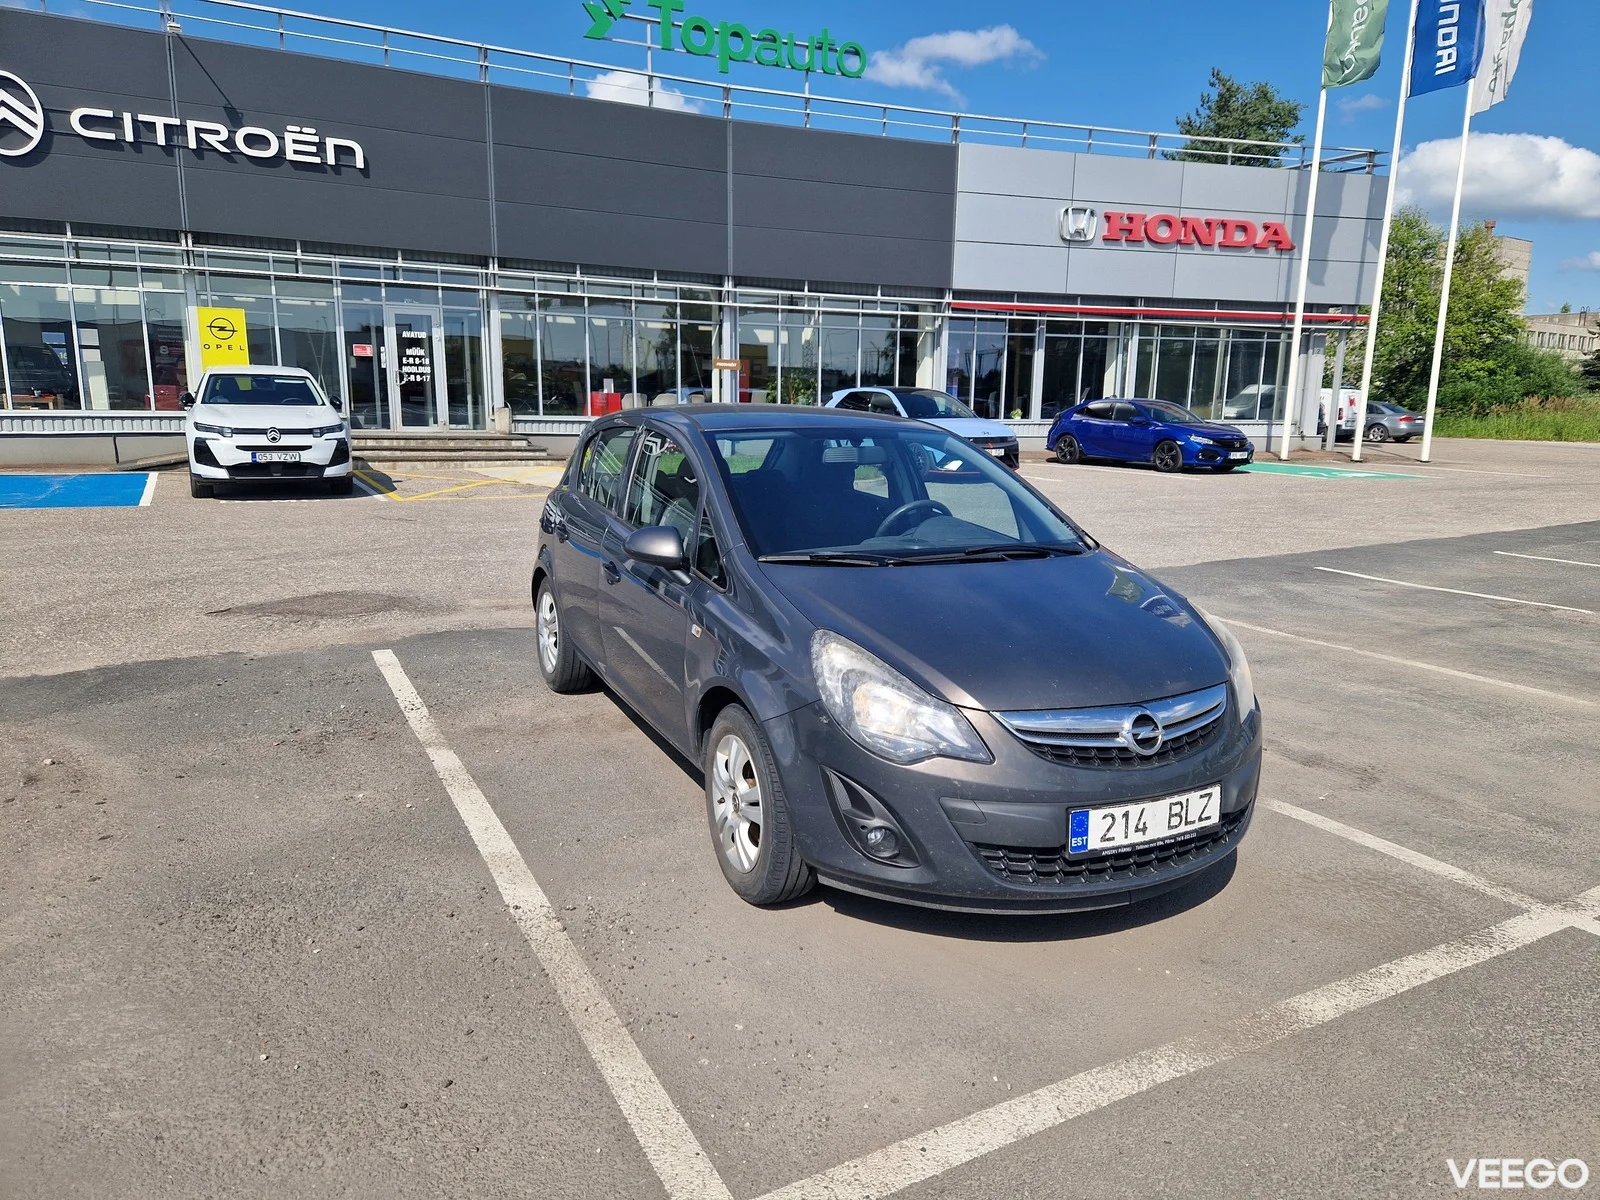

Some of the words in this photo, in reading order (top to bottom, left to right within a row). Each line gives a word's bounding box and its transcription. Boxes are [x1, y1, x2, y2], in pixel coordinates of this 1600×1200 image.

[647, 0, 867, 78] Topauto
[1434, 0, 1461, 76] NDAI
[69, 106, 366, 169] CITROËN
[1101, 211, 1297, 251] HONDA
[402, 330, 427, 338] AVATUD
[203, 343, 245, 351] OPEL
[405, 347, 425, 355] MÜÜK
[416, 374, 431, 382] 8-17
[257, 453, 273, 461] 053
[276, 453, 298, 461] VZW
[1099, 807, 1148, 843] 214
[1167, 792, 1213, 831] BLZ
[1071, 836, 1088, 847] EST
